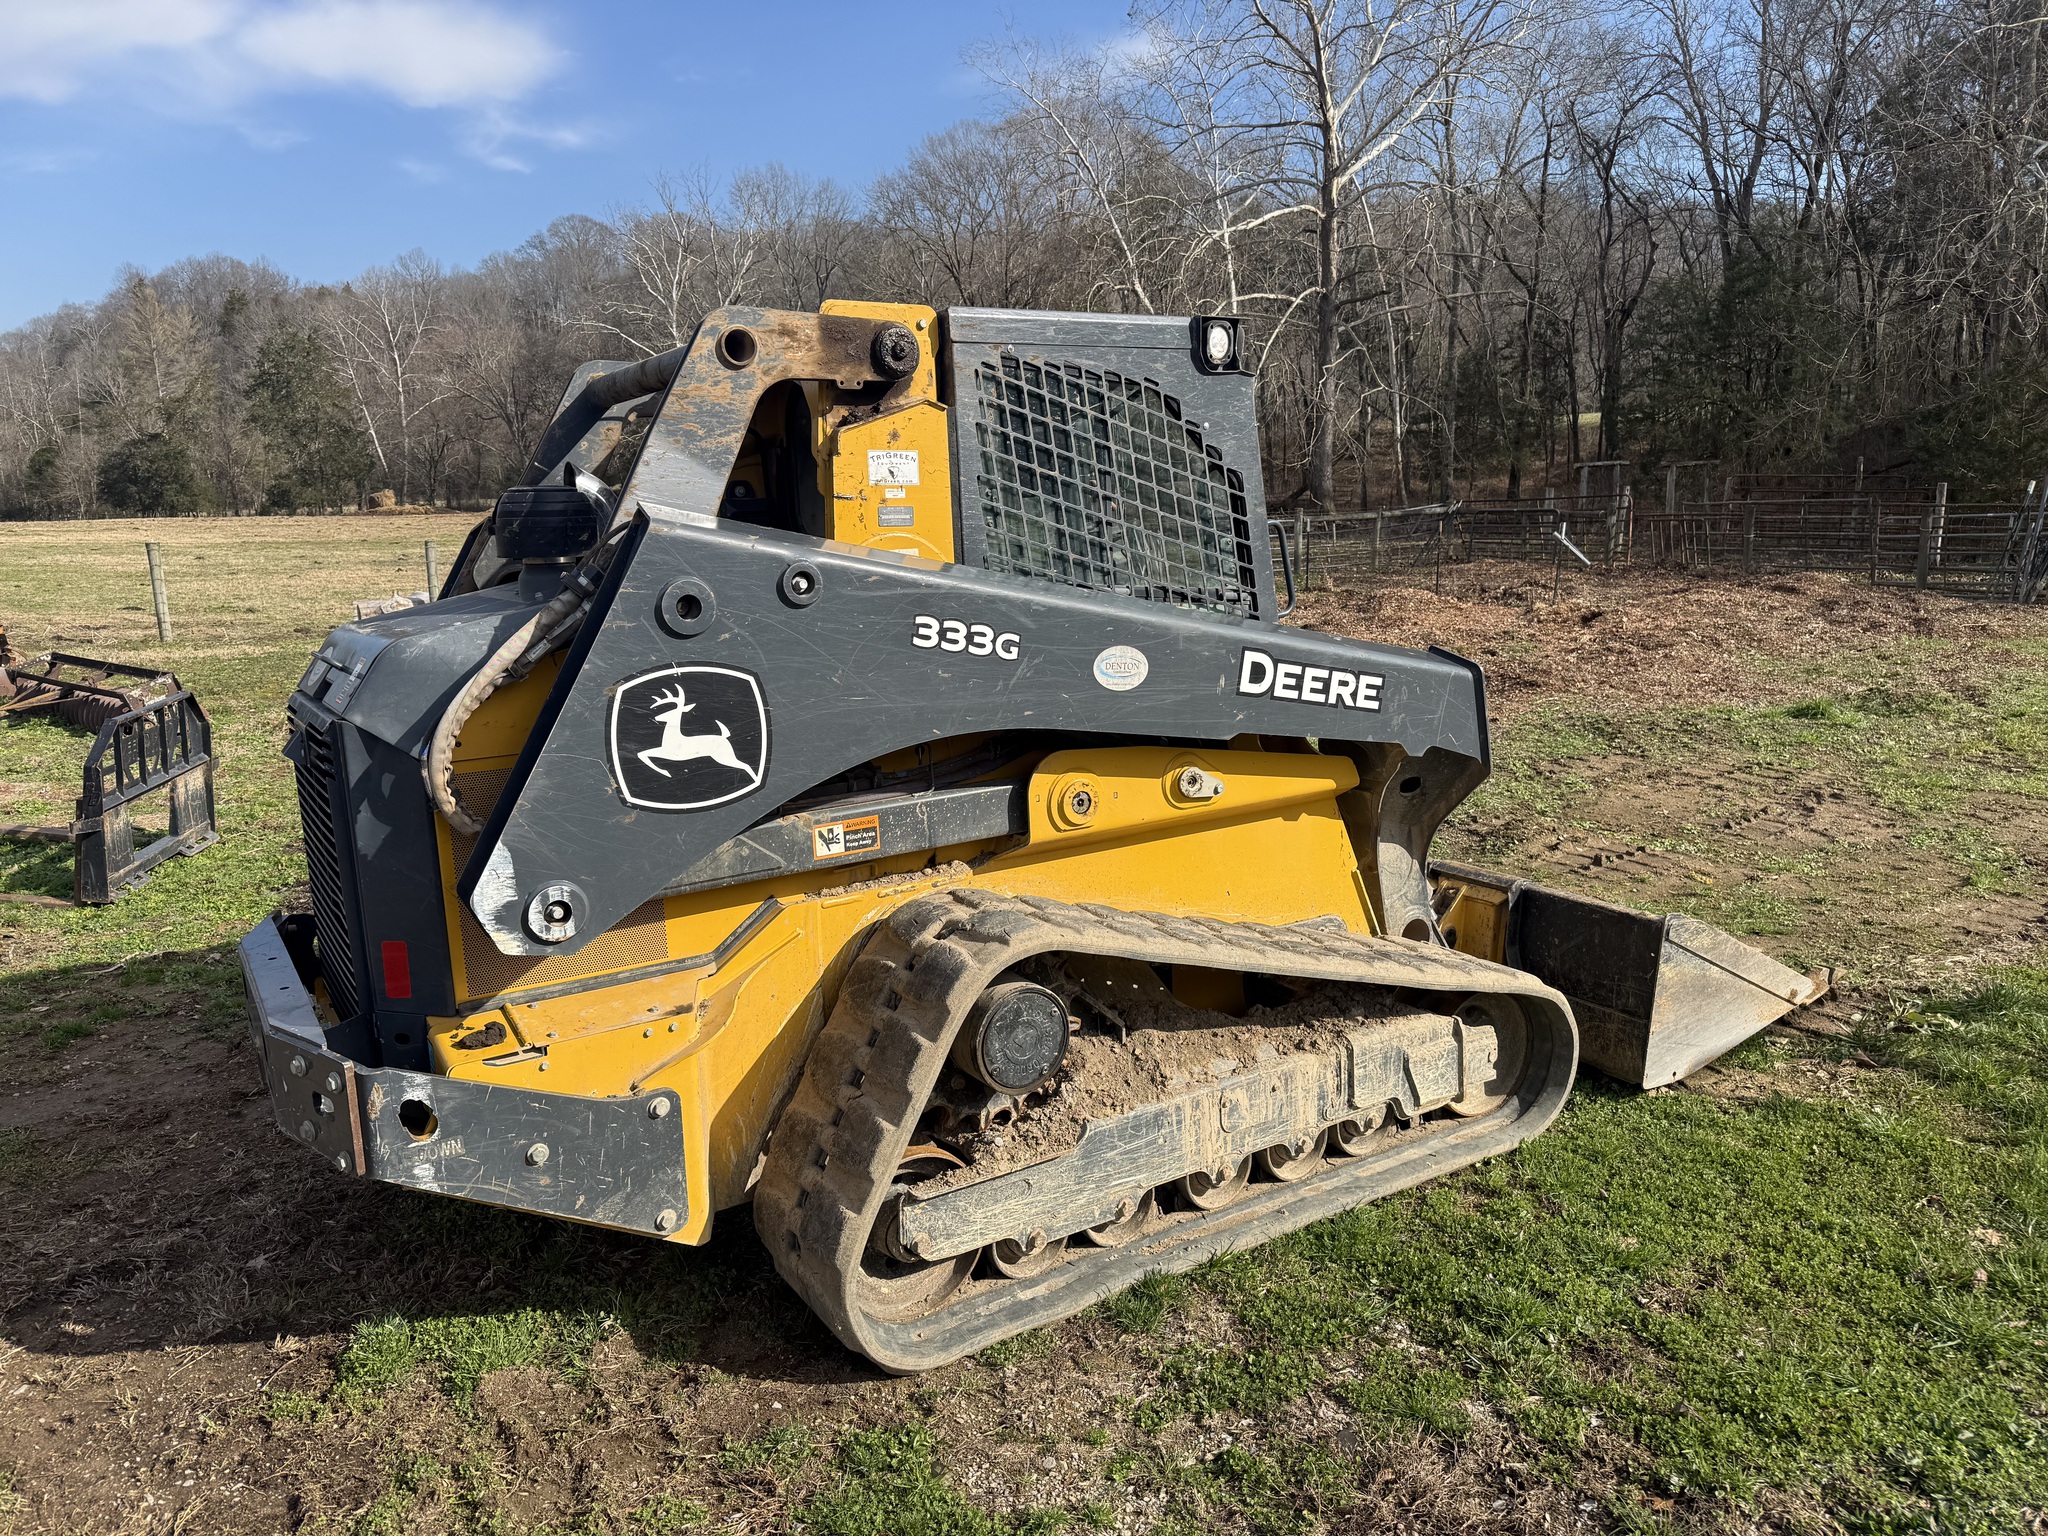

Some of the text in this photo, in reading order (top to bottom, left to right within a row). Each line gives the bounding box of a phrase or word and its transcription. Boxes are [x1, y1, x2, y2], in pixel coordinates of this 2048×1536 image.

[911, 615, 1021, 661] 333G
[1105, 662, 1140, 671] DENTON
[1238, 648, 1385, 711] DEERE
[851, 819, 876, 827] WARNING
[418, 1138, 462, 1162] DOWN
